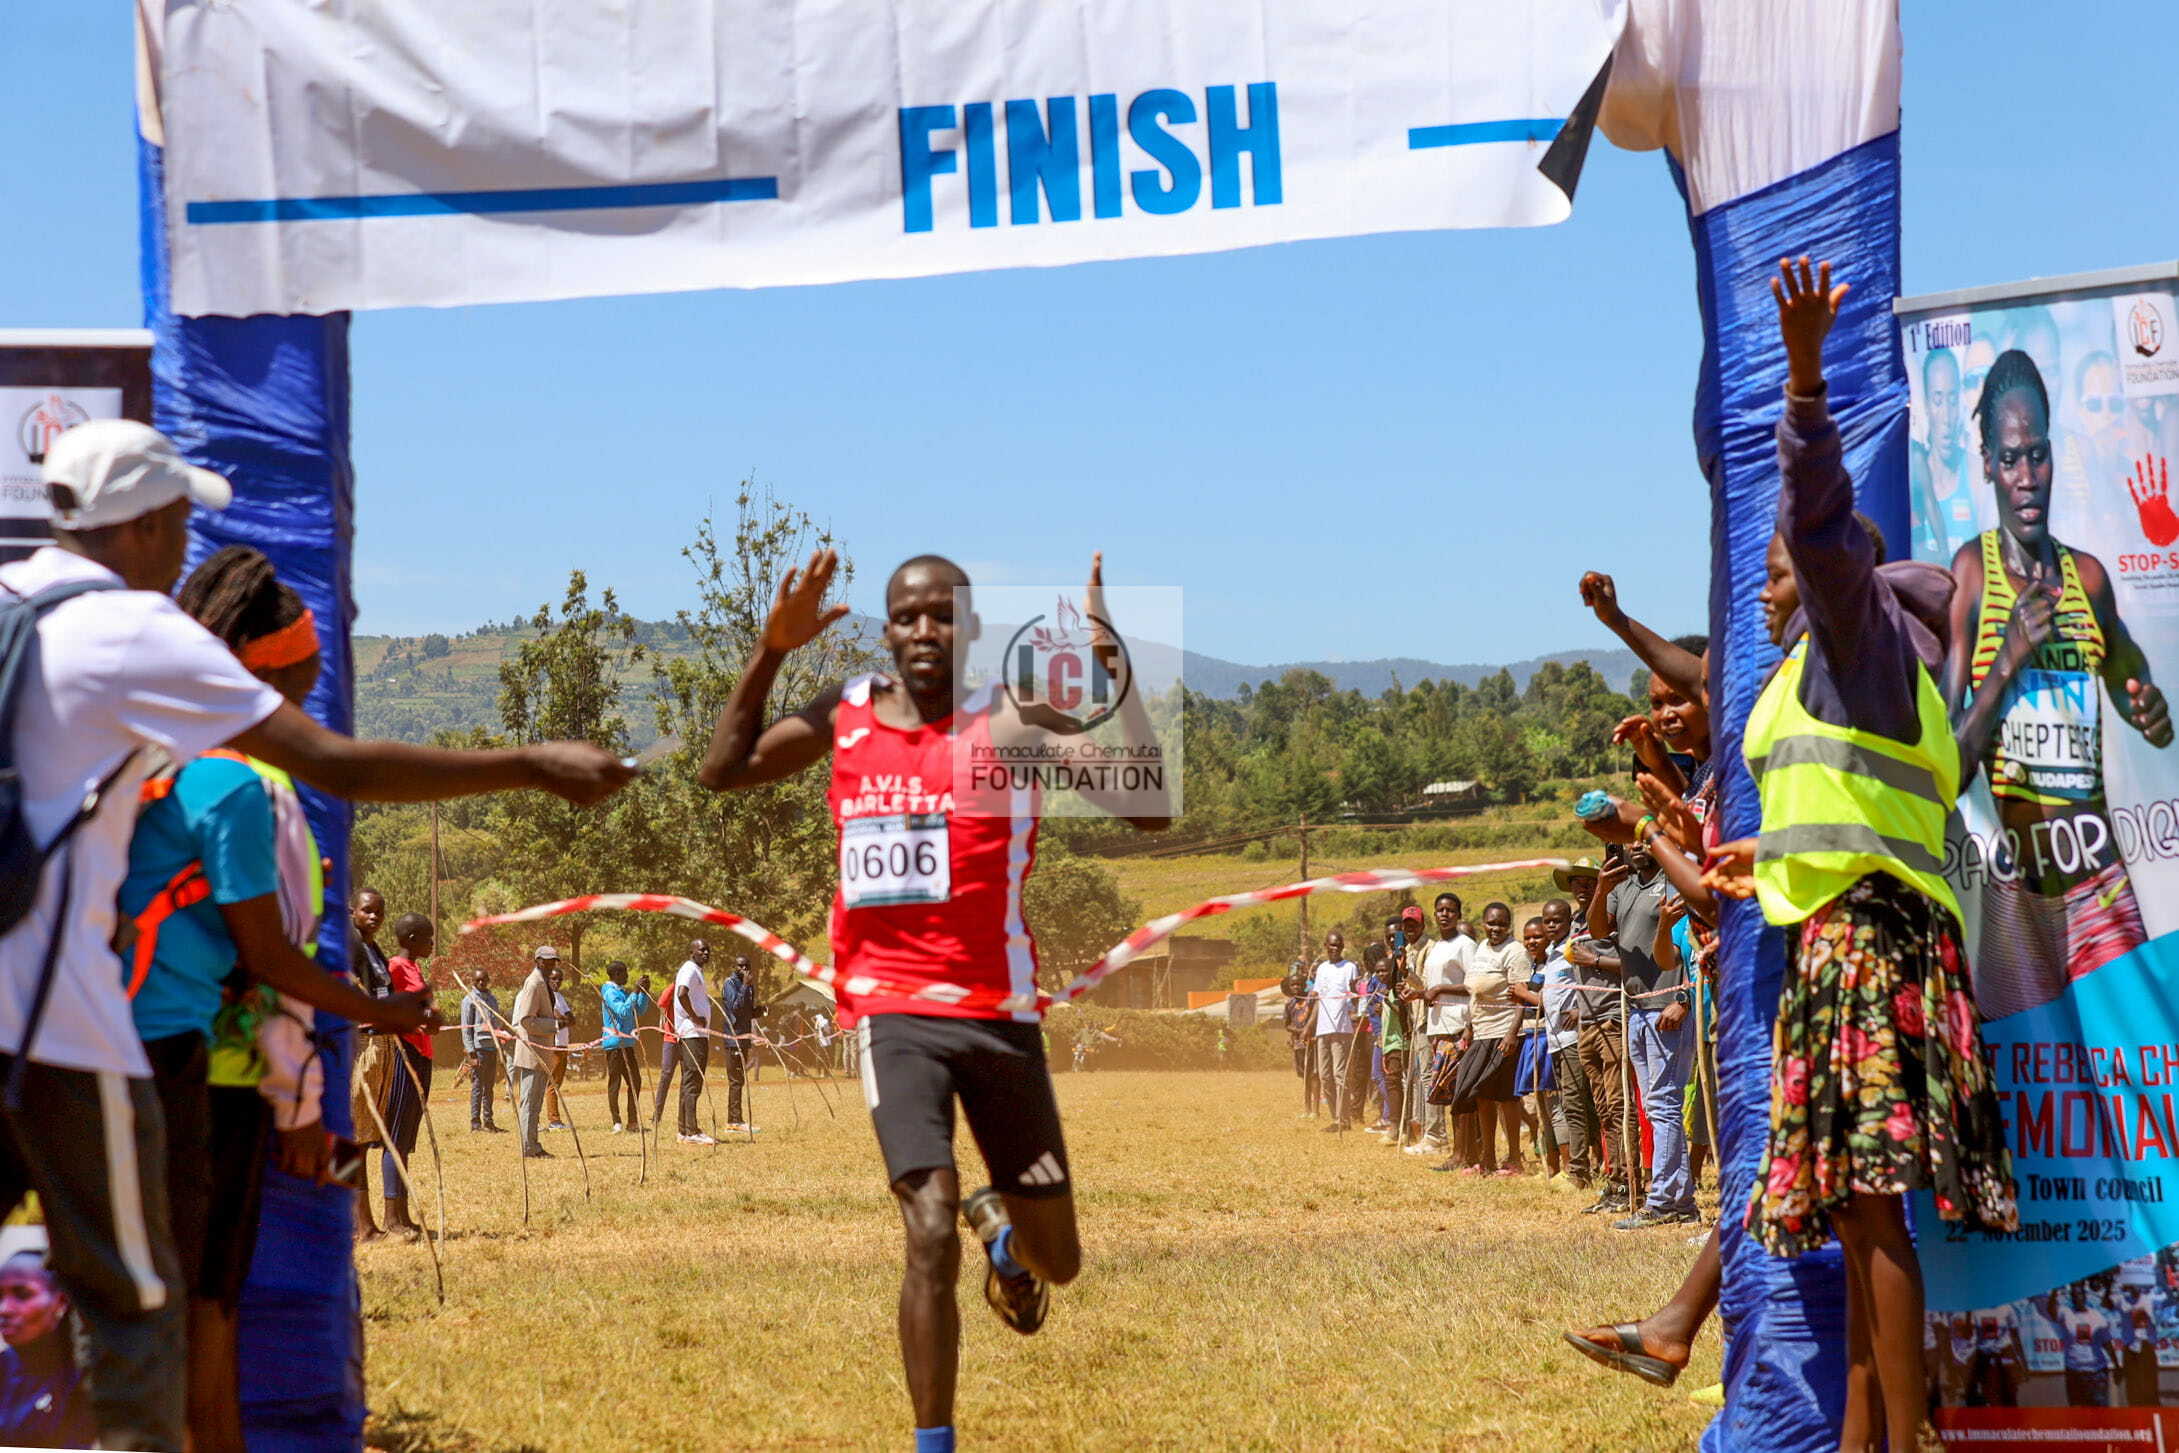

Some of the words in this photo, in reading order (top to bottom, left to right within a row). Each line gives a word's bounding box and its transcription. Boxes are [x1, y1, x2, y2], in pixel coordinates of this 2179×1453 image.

[898, 82, 1283, 233] FINISH
[1926, 322, 1971, 351] Edition
[841, 793, 956, 817] BARLETTA
[846, 841, 937, 882] 0606
[2030, 813, 2107, 878] FOR
[2011, 1042, 2133, 1088] REBECA
[2027, 1173, 2087, 1201] Town
[2077, 1220, 2127, 1242] 2025
